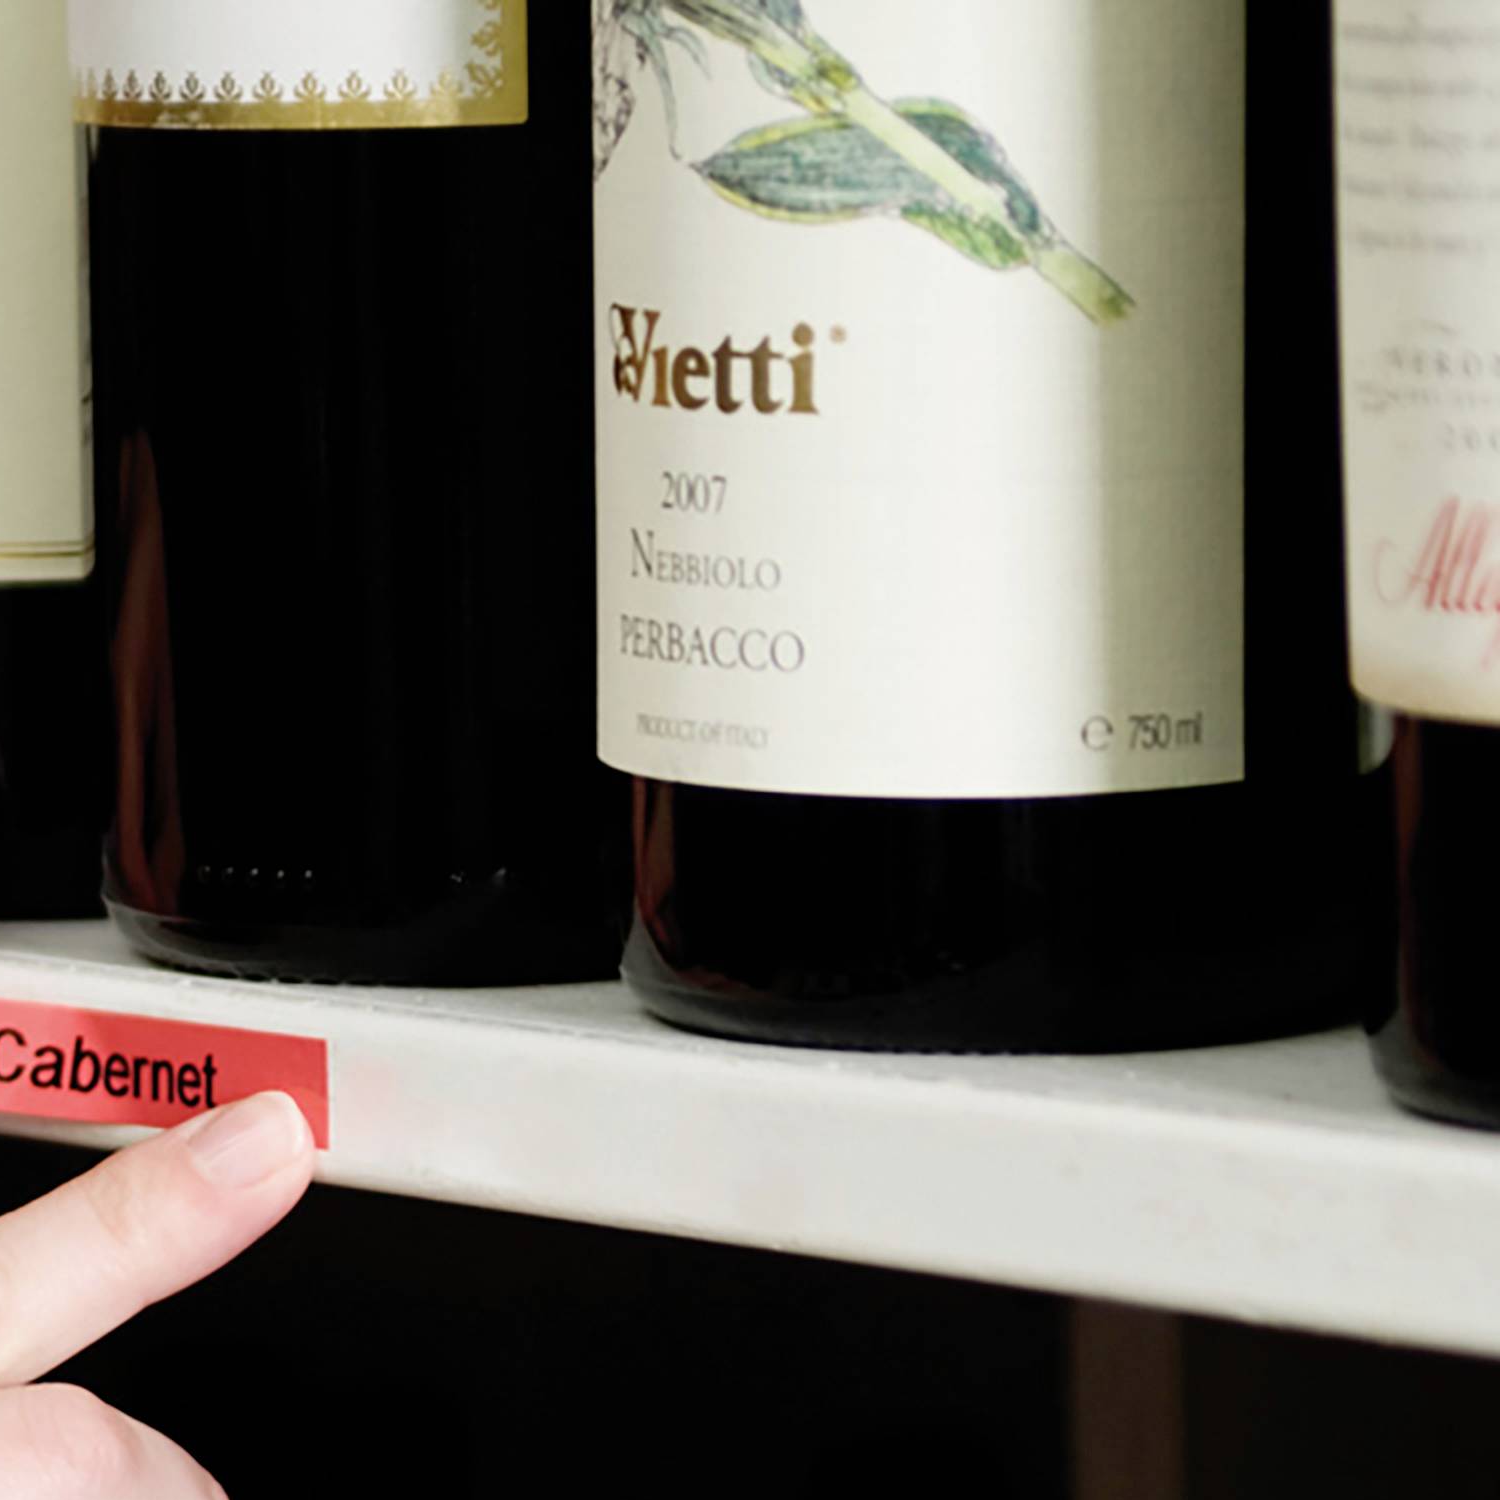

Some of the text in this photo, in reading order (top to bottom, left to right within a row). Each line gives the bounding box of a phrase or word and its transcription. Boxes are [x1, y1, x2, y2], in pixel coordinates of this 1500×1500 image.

[609, 302, 819, 415] Vietti
[661, 471, 727, 513] 2007
[630, 527, 781, 591] NEBBIOLO
[620, 613, 804, 673] PERBACCO
[1127, 713, 1172, 750] 750
[1175, 710, 1204, 745] ml
